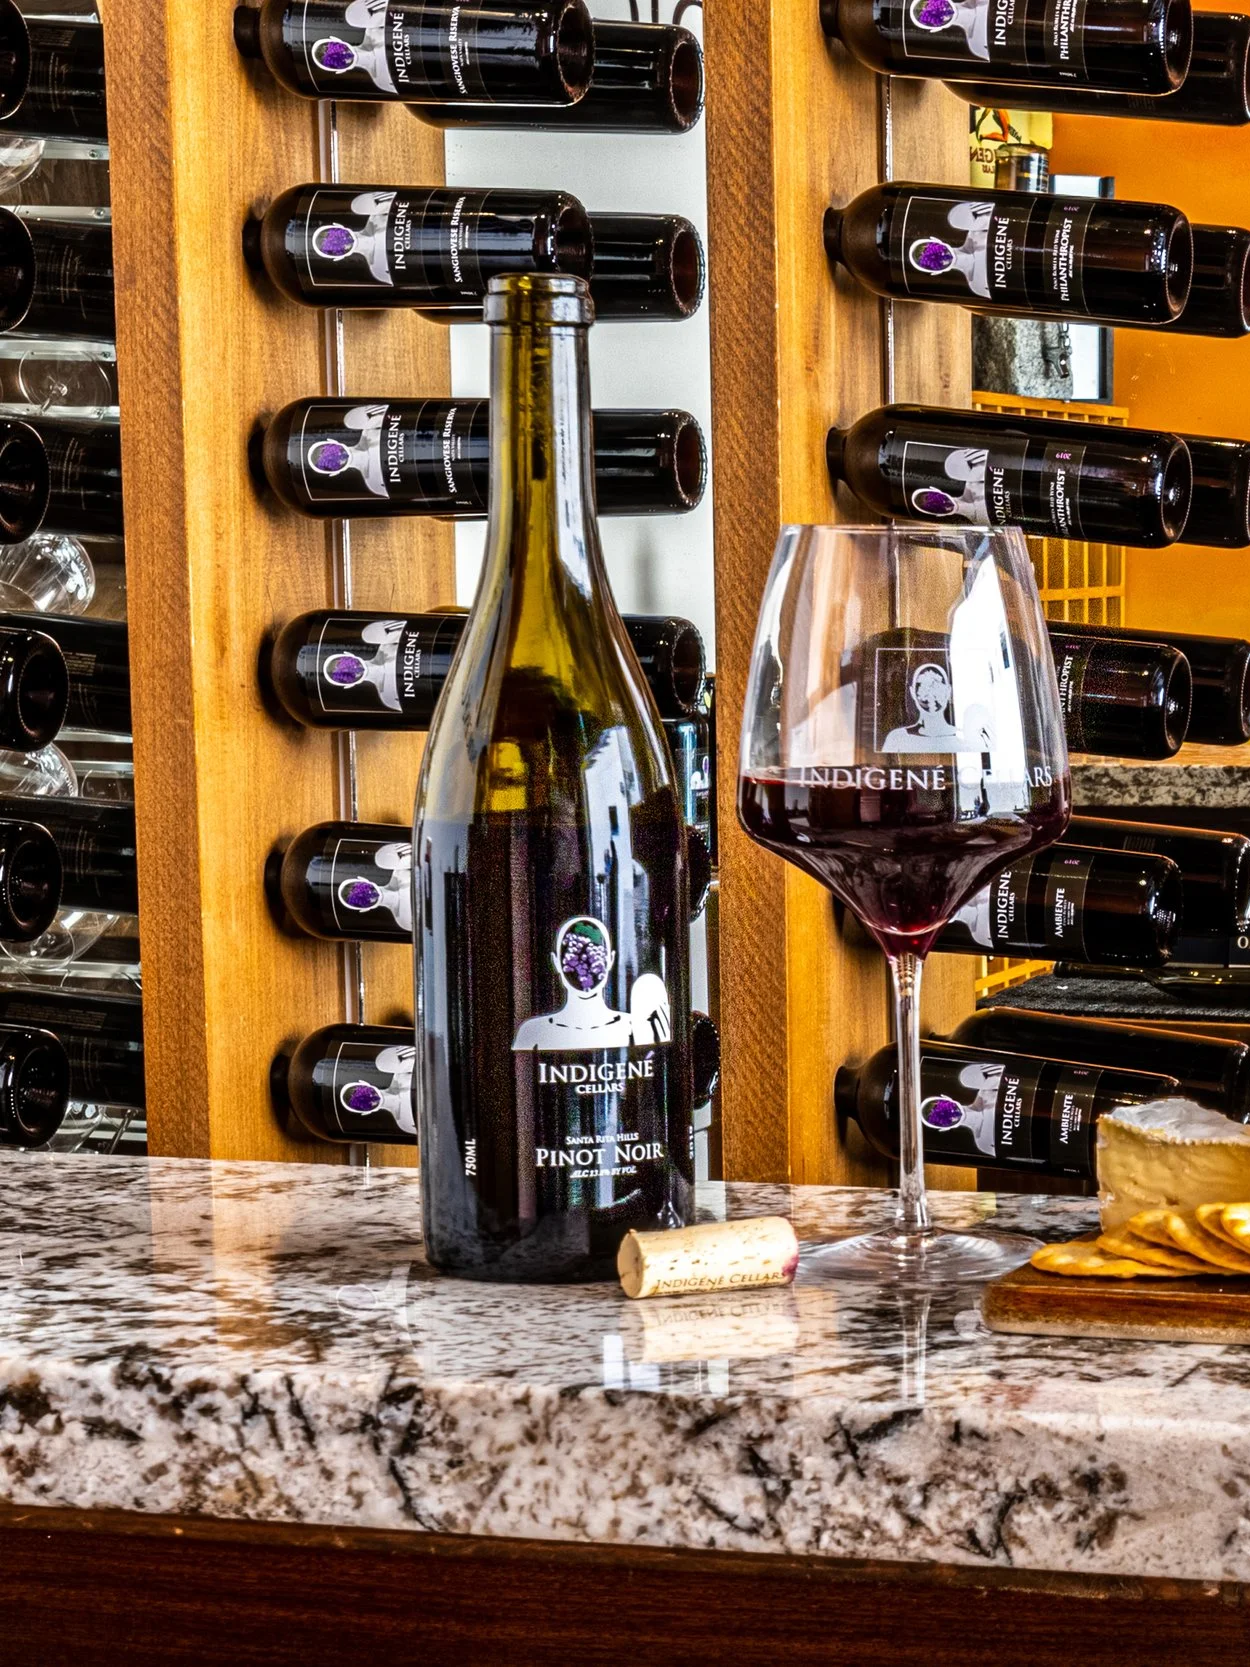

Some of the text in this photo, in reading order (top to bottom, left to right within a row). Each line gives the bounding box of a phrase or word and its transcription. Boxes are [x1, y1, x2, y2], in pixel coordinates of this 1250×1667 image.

[390, 12, 410, 82] INDIGENÉ
[994, 0, 1008, 46] INDIG
[1060, 0, 1071, 59] PHILANTHR
[403, 34, 412, 65] CELLARS
[448, 6, 468, 94] SANGIOVESE RISERVA
[395, 201, 409, 270] INDIGENÉ
[404, 219, 412, 250] CELLARS
[450, 196, 466, 283] SANGIOVESE RISERVA
[994, 216, 1009, 288] INDIGENÉ
[1059, 218, 1072, 301] PHILANTHROPIST
[387, 414, 401, 482] INDIGENÉ
[443, 407, 457, 493] SANGIOVESE RISERVA
[403, 631, 419, 698] INDIGENÉ
[800, 764, 946, 791] INDIGENÉ
[1055, 888, 1065, 937] AMBIENTE
[539, 1050, 655, 1084] INDIGENÉ
[575, 1083, 625, 1095] CELLARS
[1001, 1077, 1019, 1145] INDIGENÉ
[1014, 1098, 1022, 1127] CELLARS
[1060, 1095, 1073, 1144] AMBIENTE
[464, 1138, 477, 1176] 750ML
[535, 1142, 665, 1168] PINOT NOIR
[566, 1132, 639, 1145] SANTA RITA HILLS
